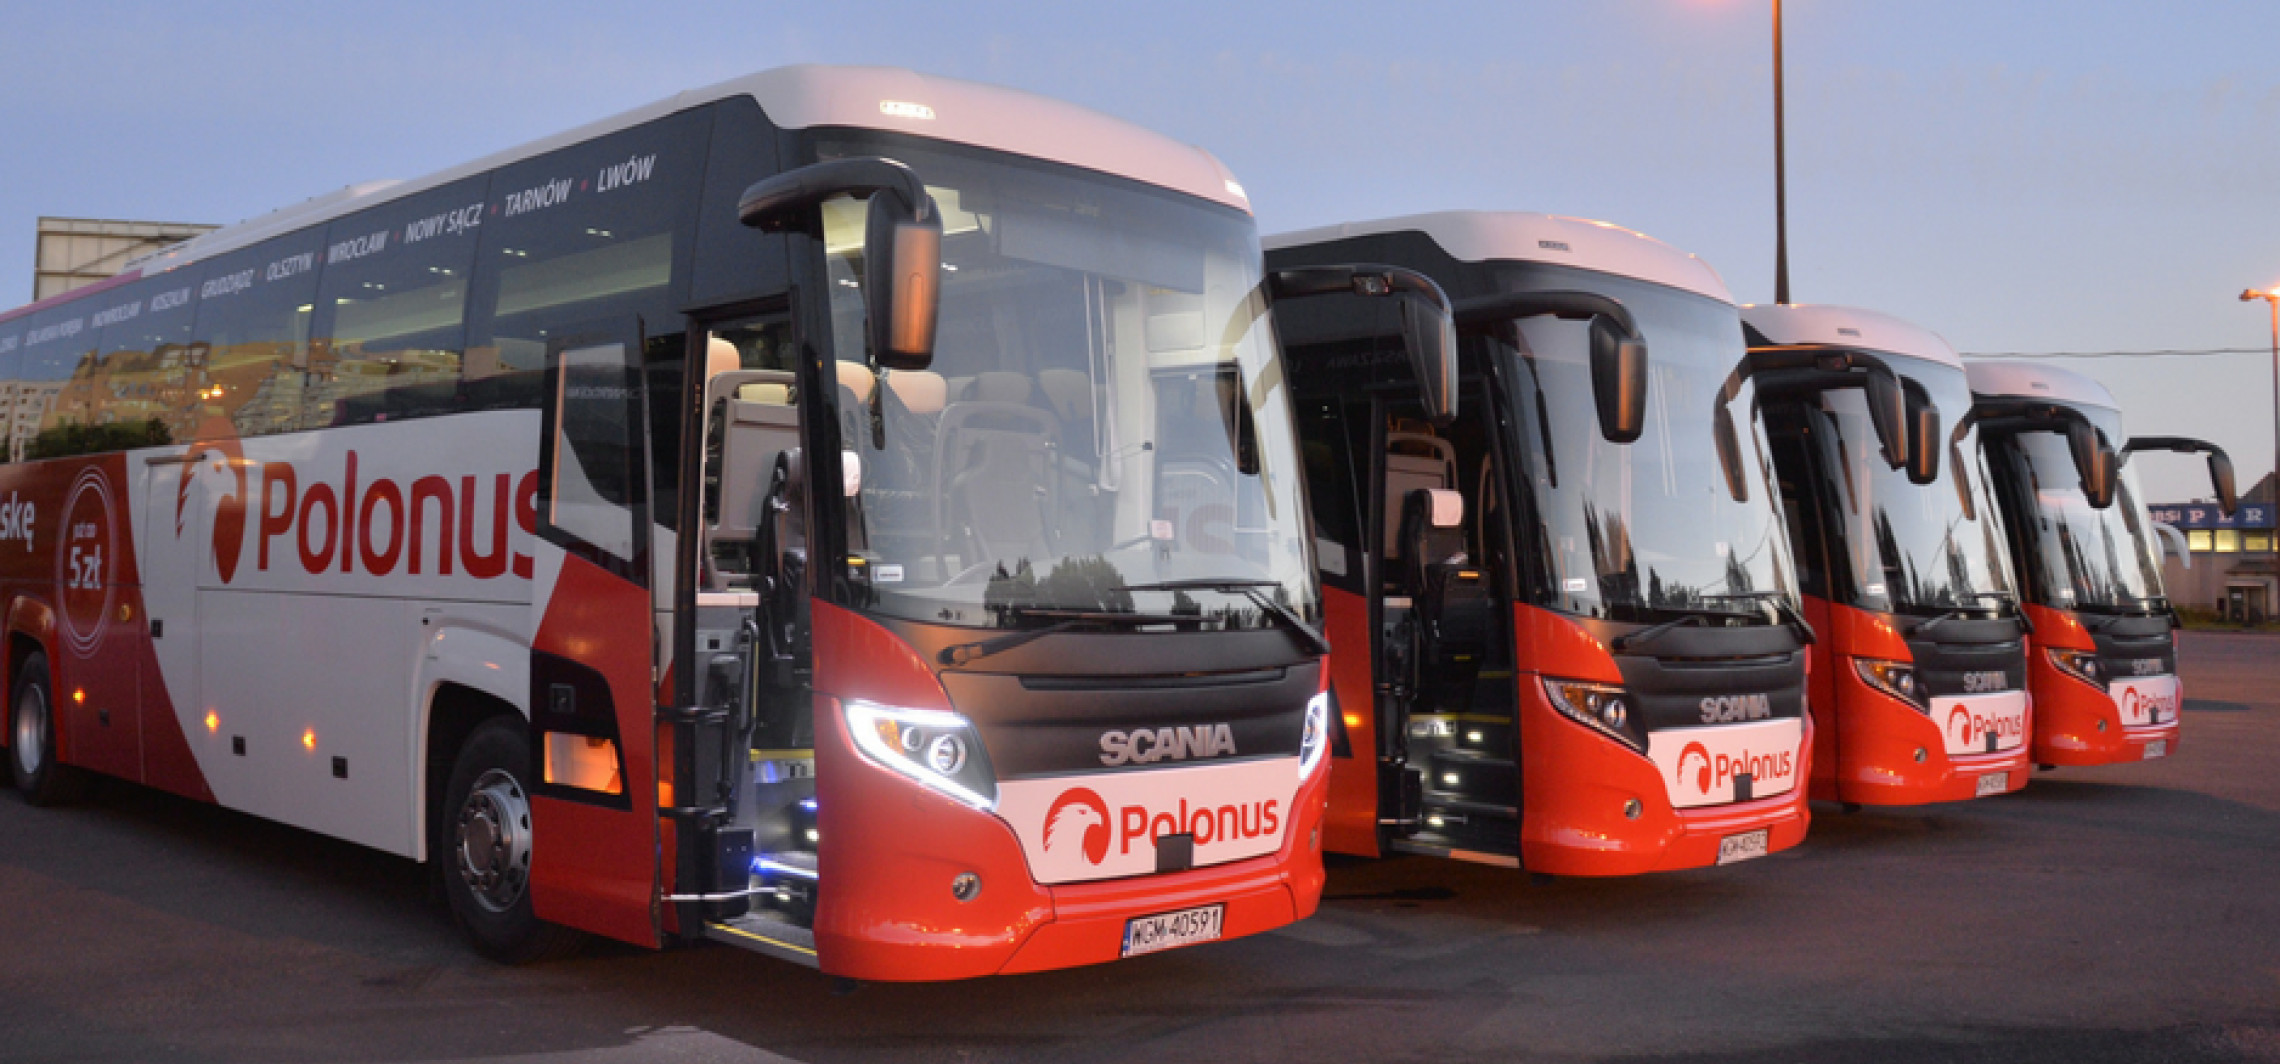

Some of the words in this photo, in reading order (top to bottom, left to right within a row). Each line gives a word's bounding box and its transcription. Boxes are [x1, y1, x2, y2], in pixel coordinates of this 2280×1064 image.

[267, 252, 314, 281] OLSZTYN
[328, 230, 389, 264] WROCŁAW
[404, 213, 448, 243] NOWY
[447, 202, 484, 235] SĄCZ
[505, 177, 573, 217] TARNÓW
[597, 154, 656, 193] LWÓW
[70, 546, 81, 588] 5
[83, 544, 102, 589] zł
[1700, 693, 1771, 723] SCANIA
[1099, 722, 1238, 766] SCANIA
[1716, 749, 1791, 788] Polonus
[1120, 797, 1279, 854] Polonus
